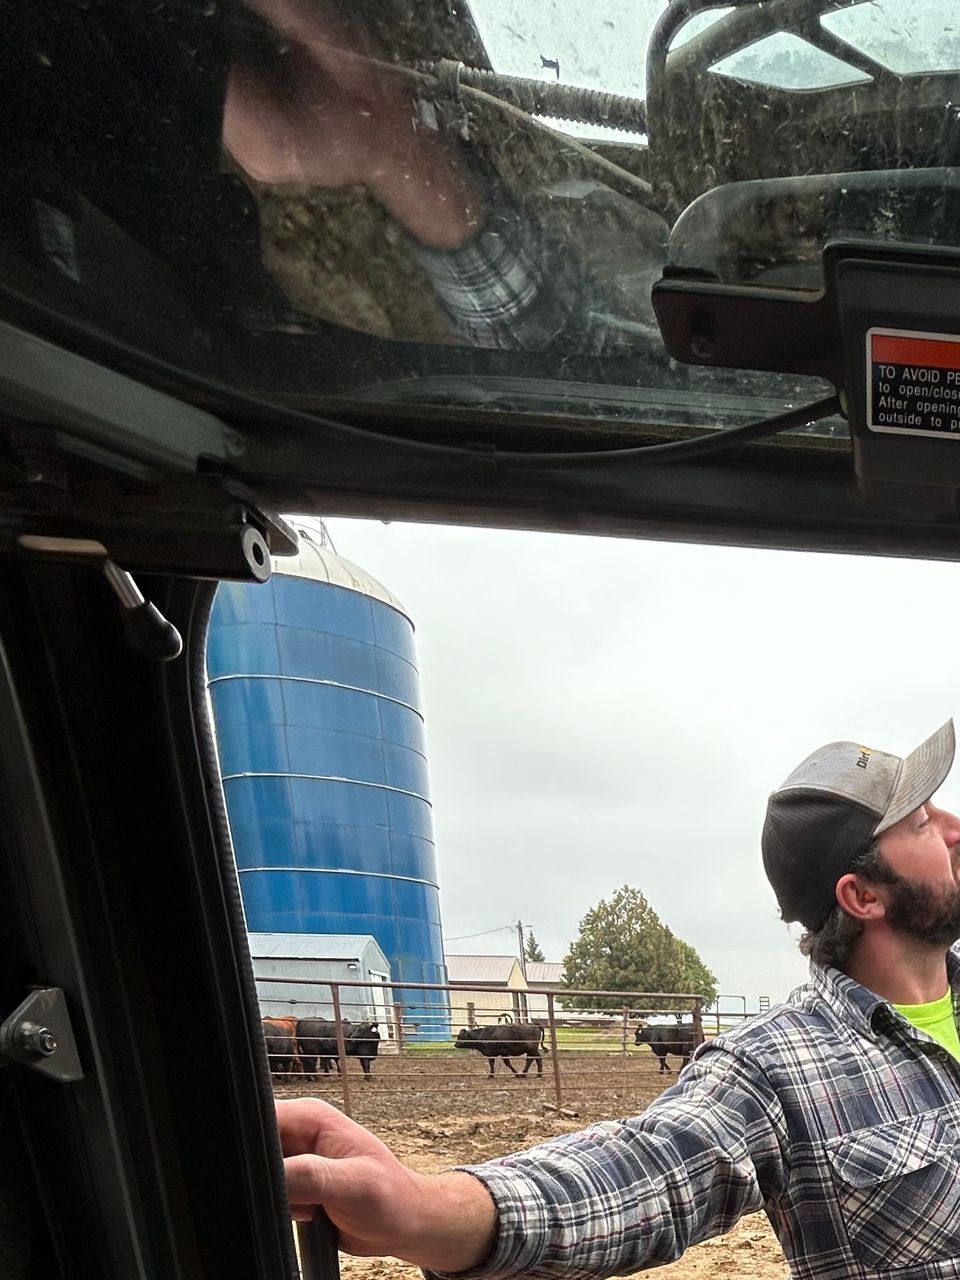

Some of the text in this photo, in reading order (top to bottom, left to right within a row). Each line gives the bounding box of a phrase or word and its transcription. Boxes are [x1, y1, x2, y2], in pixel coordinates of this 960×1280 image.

[879, 366, 895, 379] TO
[902, 368, 939, 383] AVOID
[879, 383, 890, 393] to
[879, 396, 908, 410] After
[879, 411, 922, 425] outside
[931, 416, 941, 427] to
